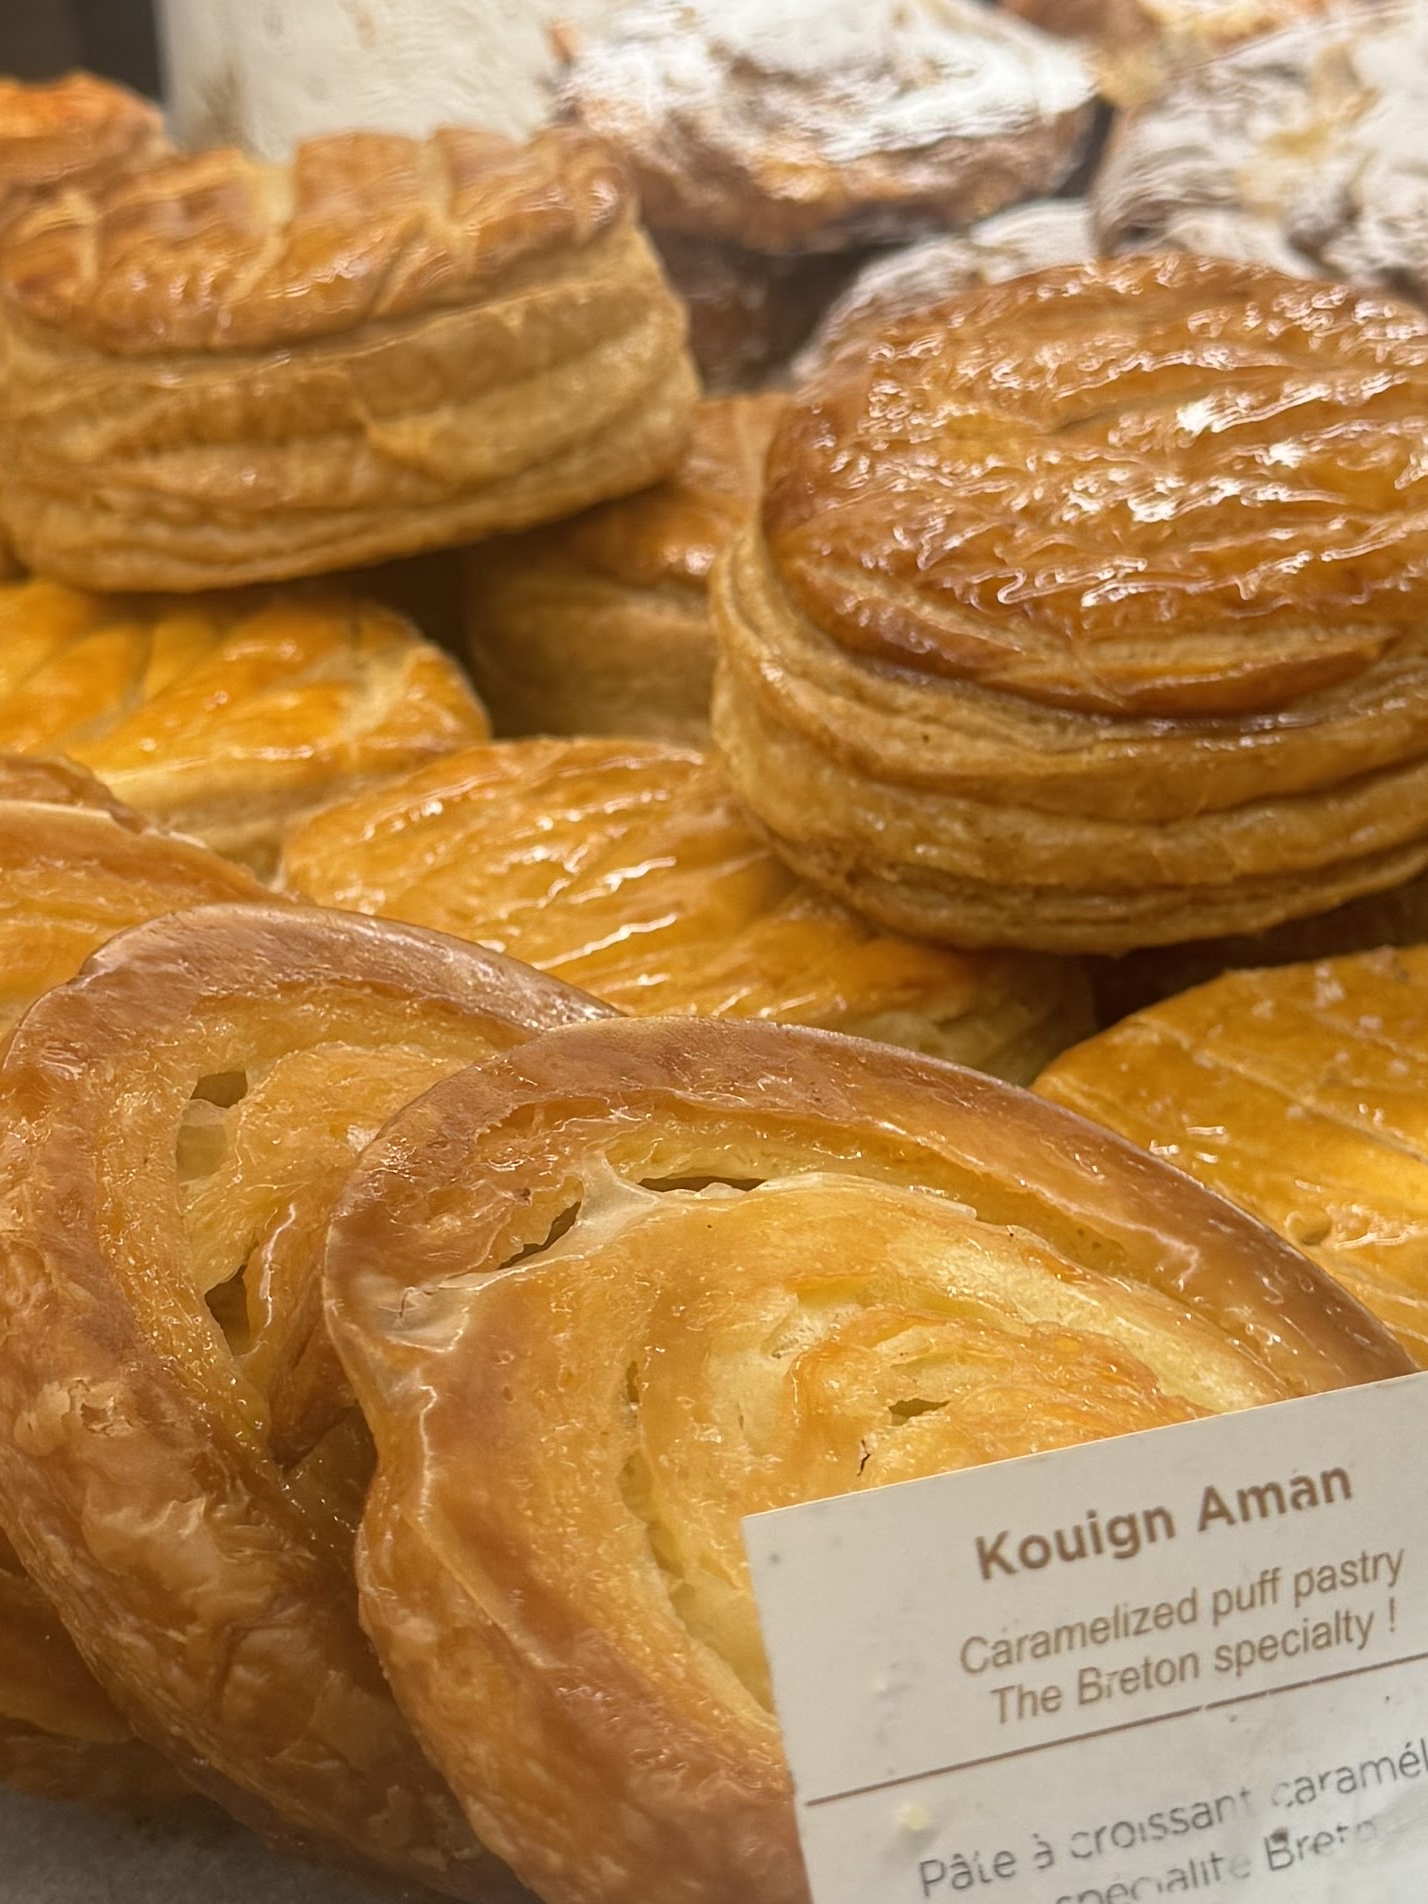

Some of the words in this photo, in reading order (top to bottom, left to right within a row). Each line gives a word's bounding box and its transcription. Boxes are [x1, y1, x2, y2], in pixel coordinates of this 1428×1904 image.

[974, 1506, 1176, 1580] Kouign
[1197, 1465, 1353, 1532] Aman
[959, 1586, 1199, 1676] Caramelized
[1211, 1566, 1283, 1627] puff
[1293, 1548, 1406, 1607] pastry
[990, 1682, 1062, 1725] The
[1077, 1651, 1200, 1706] Breton
[1214, 1610, 1374, 1677] specialty
[1388, 1597, 1398, 1632] !
[1032, 1834, 1056, 1871] à
[1070, 1786, 1252, 1857] croissant
